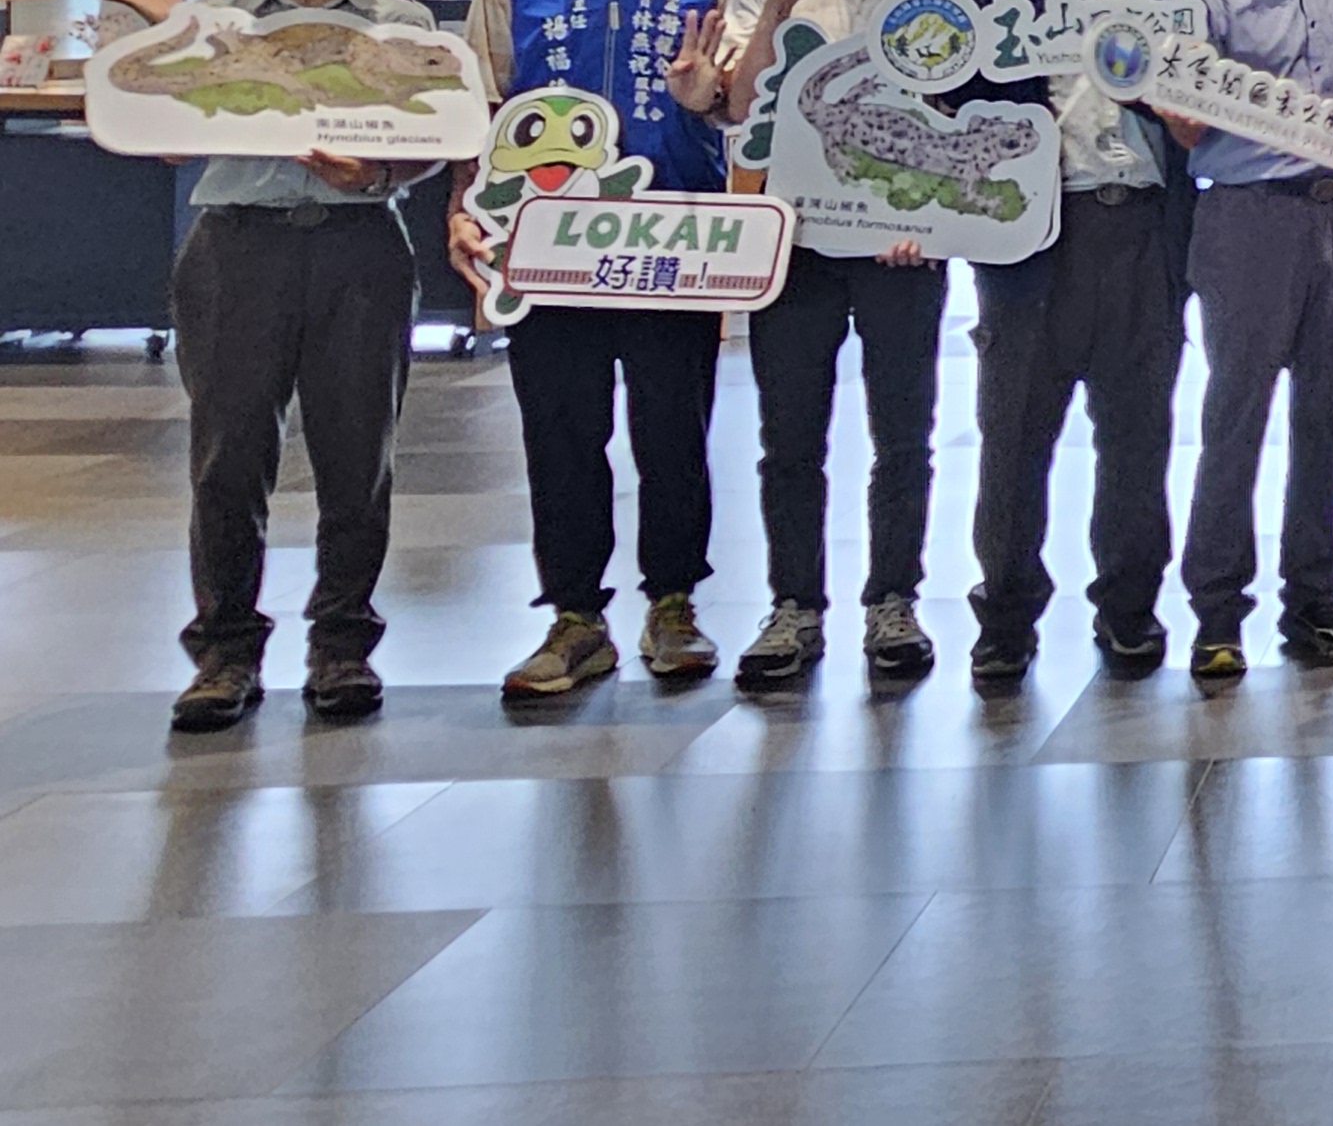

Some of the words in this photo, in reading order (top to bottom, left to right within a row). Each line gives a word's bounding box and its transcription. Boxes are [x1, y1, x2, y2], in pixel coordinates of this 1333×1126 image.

[542, 14, 572, 87] 楊福
[1036, 52, 1081, 65] Yusha
[317, 133, 382, 144] Hynobius
[553, 210, 745, 254] LOKAH
[796, 214, 853, 227] ynobius
[856, 218, 934, 235] formosanus
